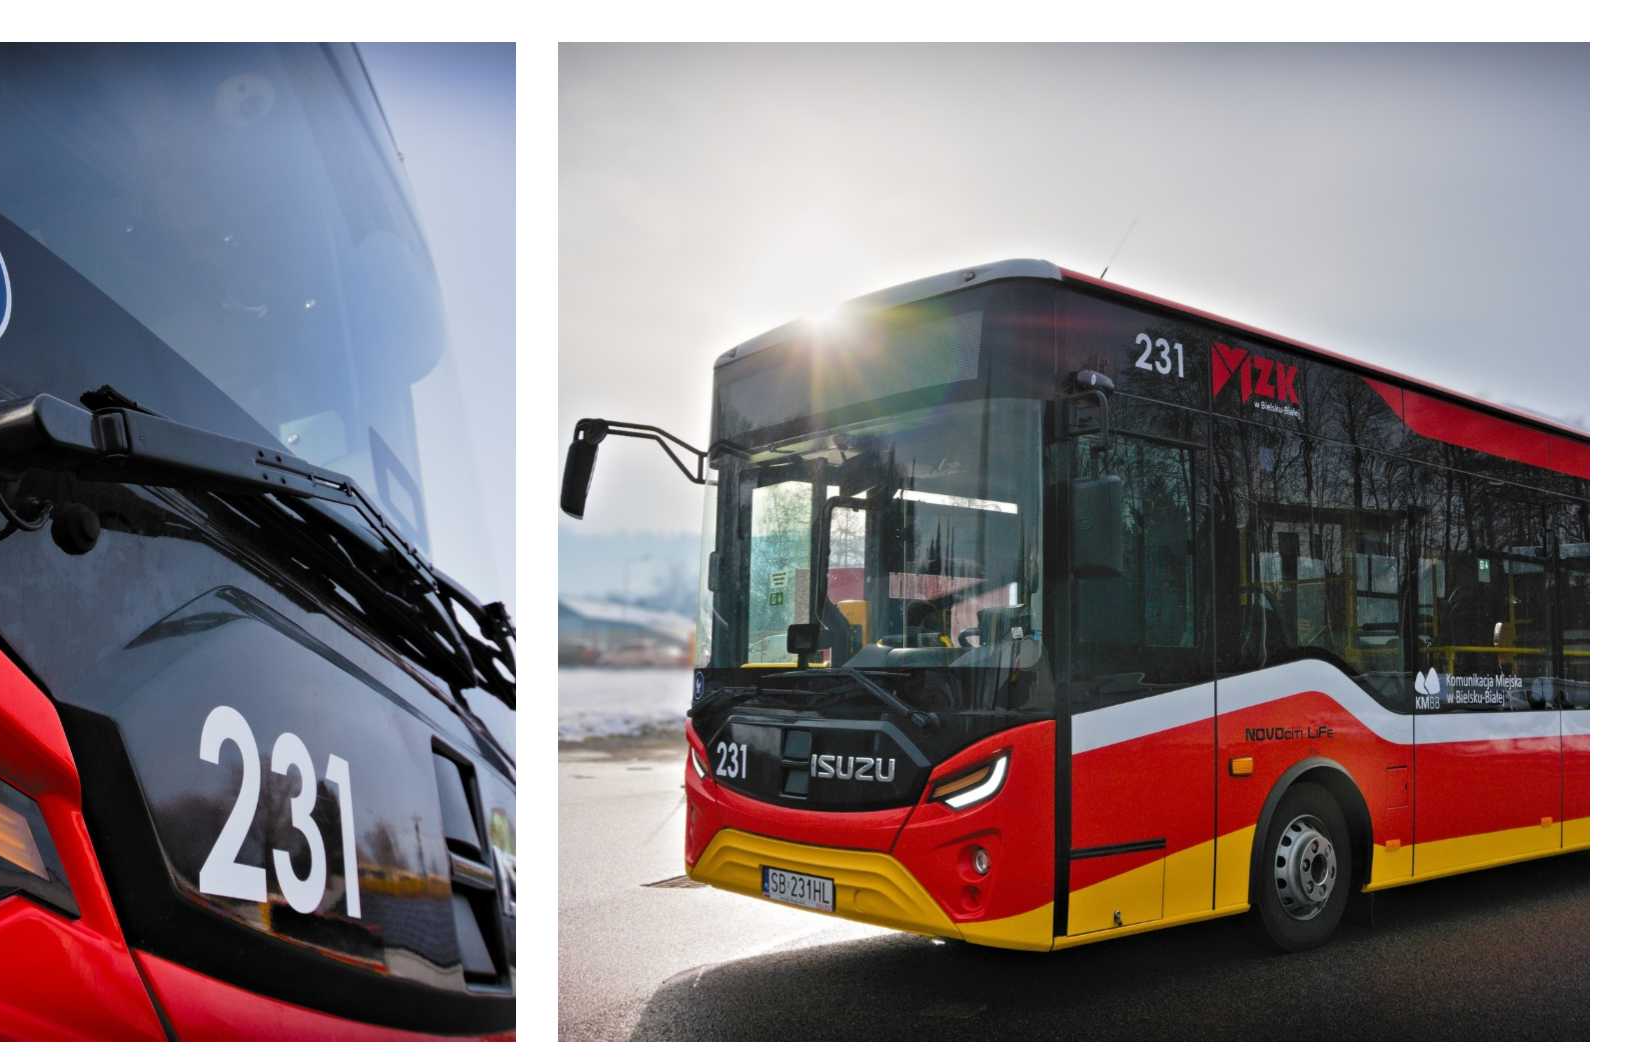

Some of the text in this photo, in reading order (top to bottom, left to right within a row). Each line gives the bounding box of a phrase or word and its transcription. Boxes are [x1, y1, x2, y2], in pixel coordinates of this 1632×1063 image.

[1135, 333, 1184, 378] 231
[1211, 341, 1300, 405] MZK
[1447, 674, 1523, 690] Komunikacja Miejska
[716, 741, 747, 779] 231
[810, 754, 896, 782] ISUZU
[199, 705, 361, 919] 231
